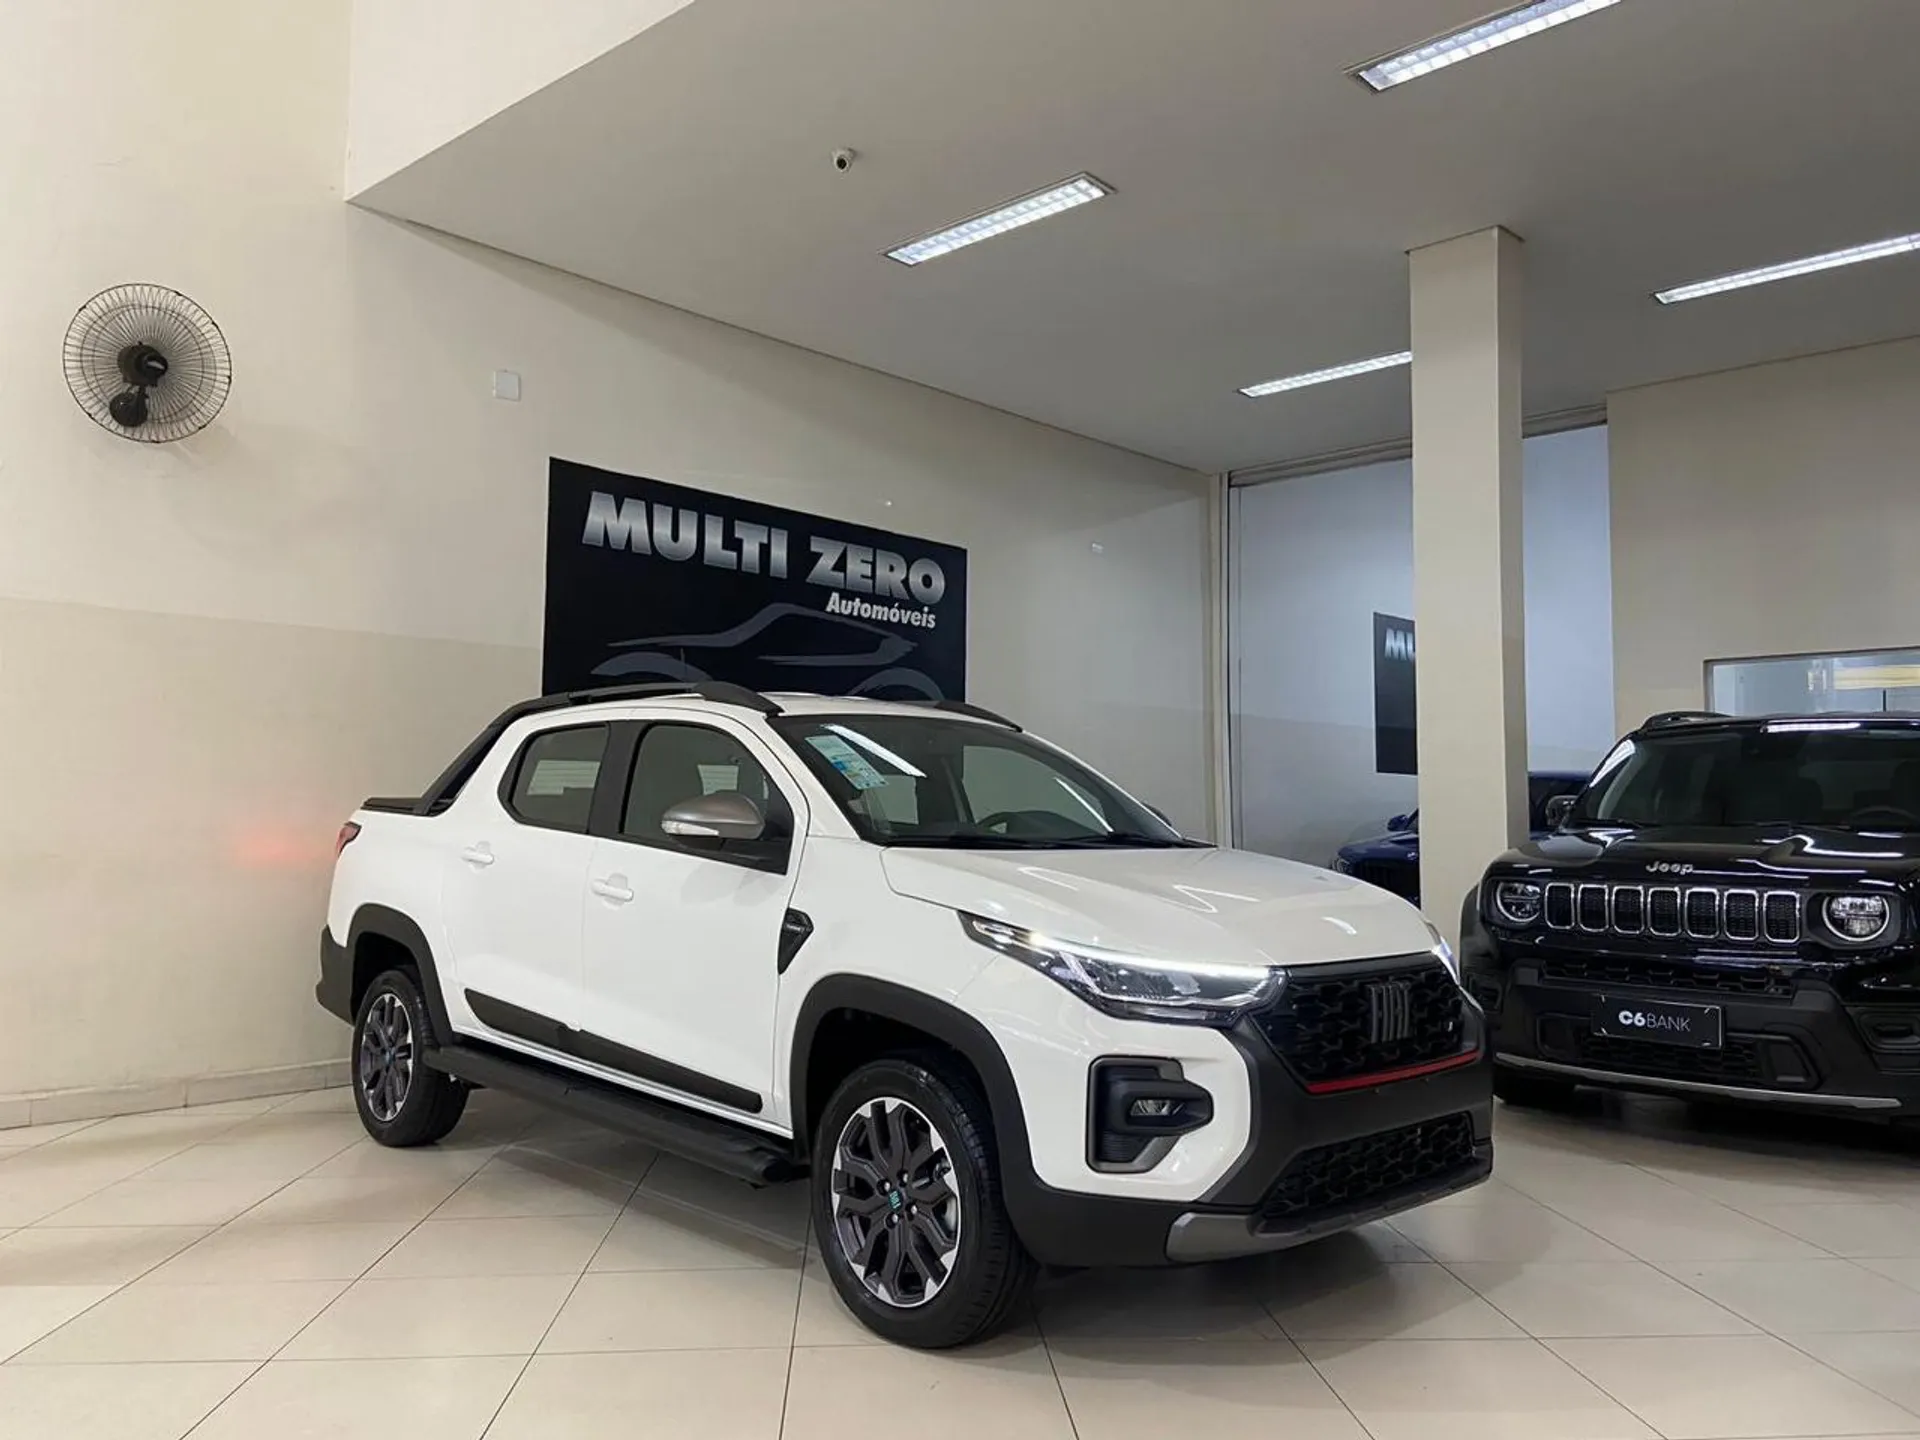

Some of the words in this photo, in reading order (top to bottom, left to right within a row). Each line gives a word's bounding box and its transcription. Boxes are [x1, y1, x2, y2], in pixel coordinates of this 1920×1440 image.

[582, 491, 788, 579] MULTI
[806, 535, 945, 604] ZERO
[825, 591, 936, 629] Automóveis
[1645, 860, 1694, 875] Jeep
[1618, 1010, 1691, 1032] C6BANK
